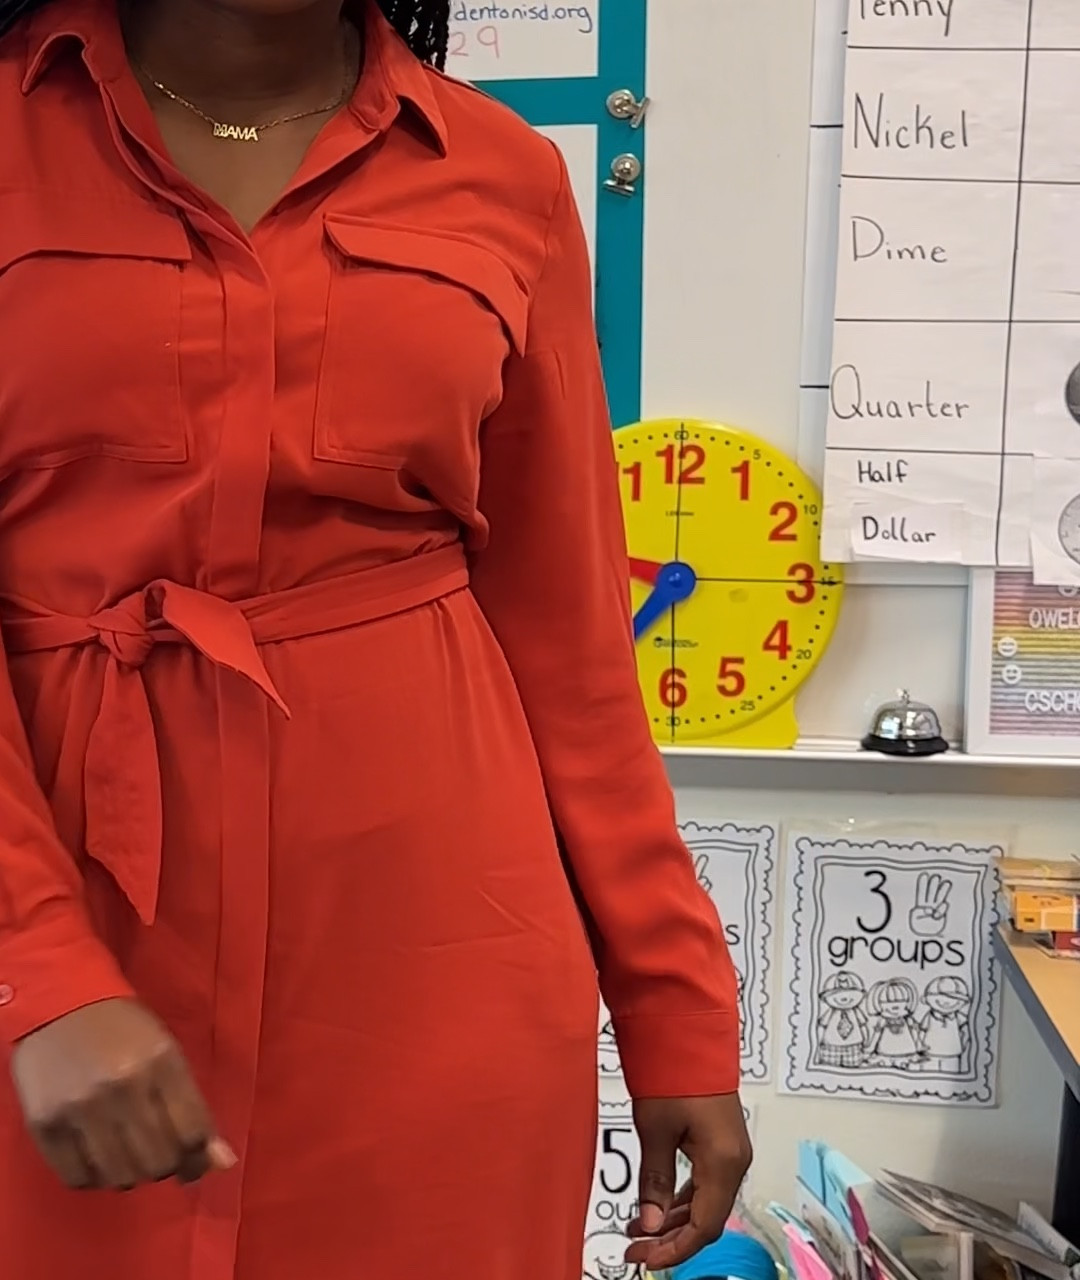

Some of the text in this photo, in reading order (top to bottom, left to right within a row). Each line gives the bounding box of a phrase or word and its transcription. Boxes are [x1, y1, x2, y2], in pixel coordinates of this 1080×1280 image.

[213, 123, 258, 141] MAMA
[854, 92, 969, 150] Nickel
[850, 216, 948, 263] Dime
[830, 364, 970, 421] Quarter
[656, 444, 705, 485] 12
[731, 460, 750, 500] 1
[857, 460, 909, 484] Half
[769, 501, 798, 541] 2
[804, 505, 818, 515] 10
[862, 515, 936, 544] Dollar
[786, 563, 815, 603] 3
[763, 620, 791, 660] 4
[796, 649, 812, 660] 20
[659, 668, 687, 709] 6
[717, 657, 745, 696] 5
[740, 701, 755, 711] 25
[857, 870, 892, 932] 3
[827, 934, 965, 970] groups
[600, 1128, 632, 1193] 5
